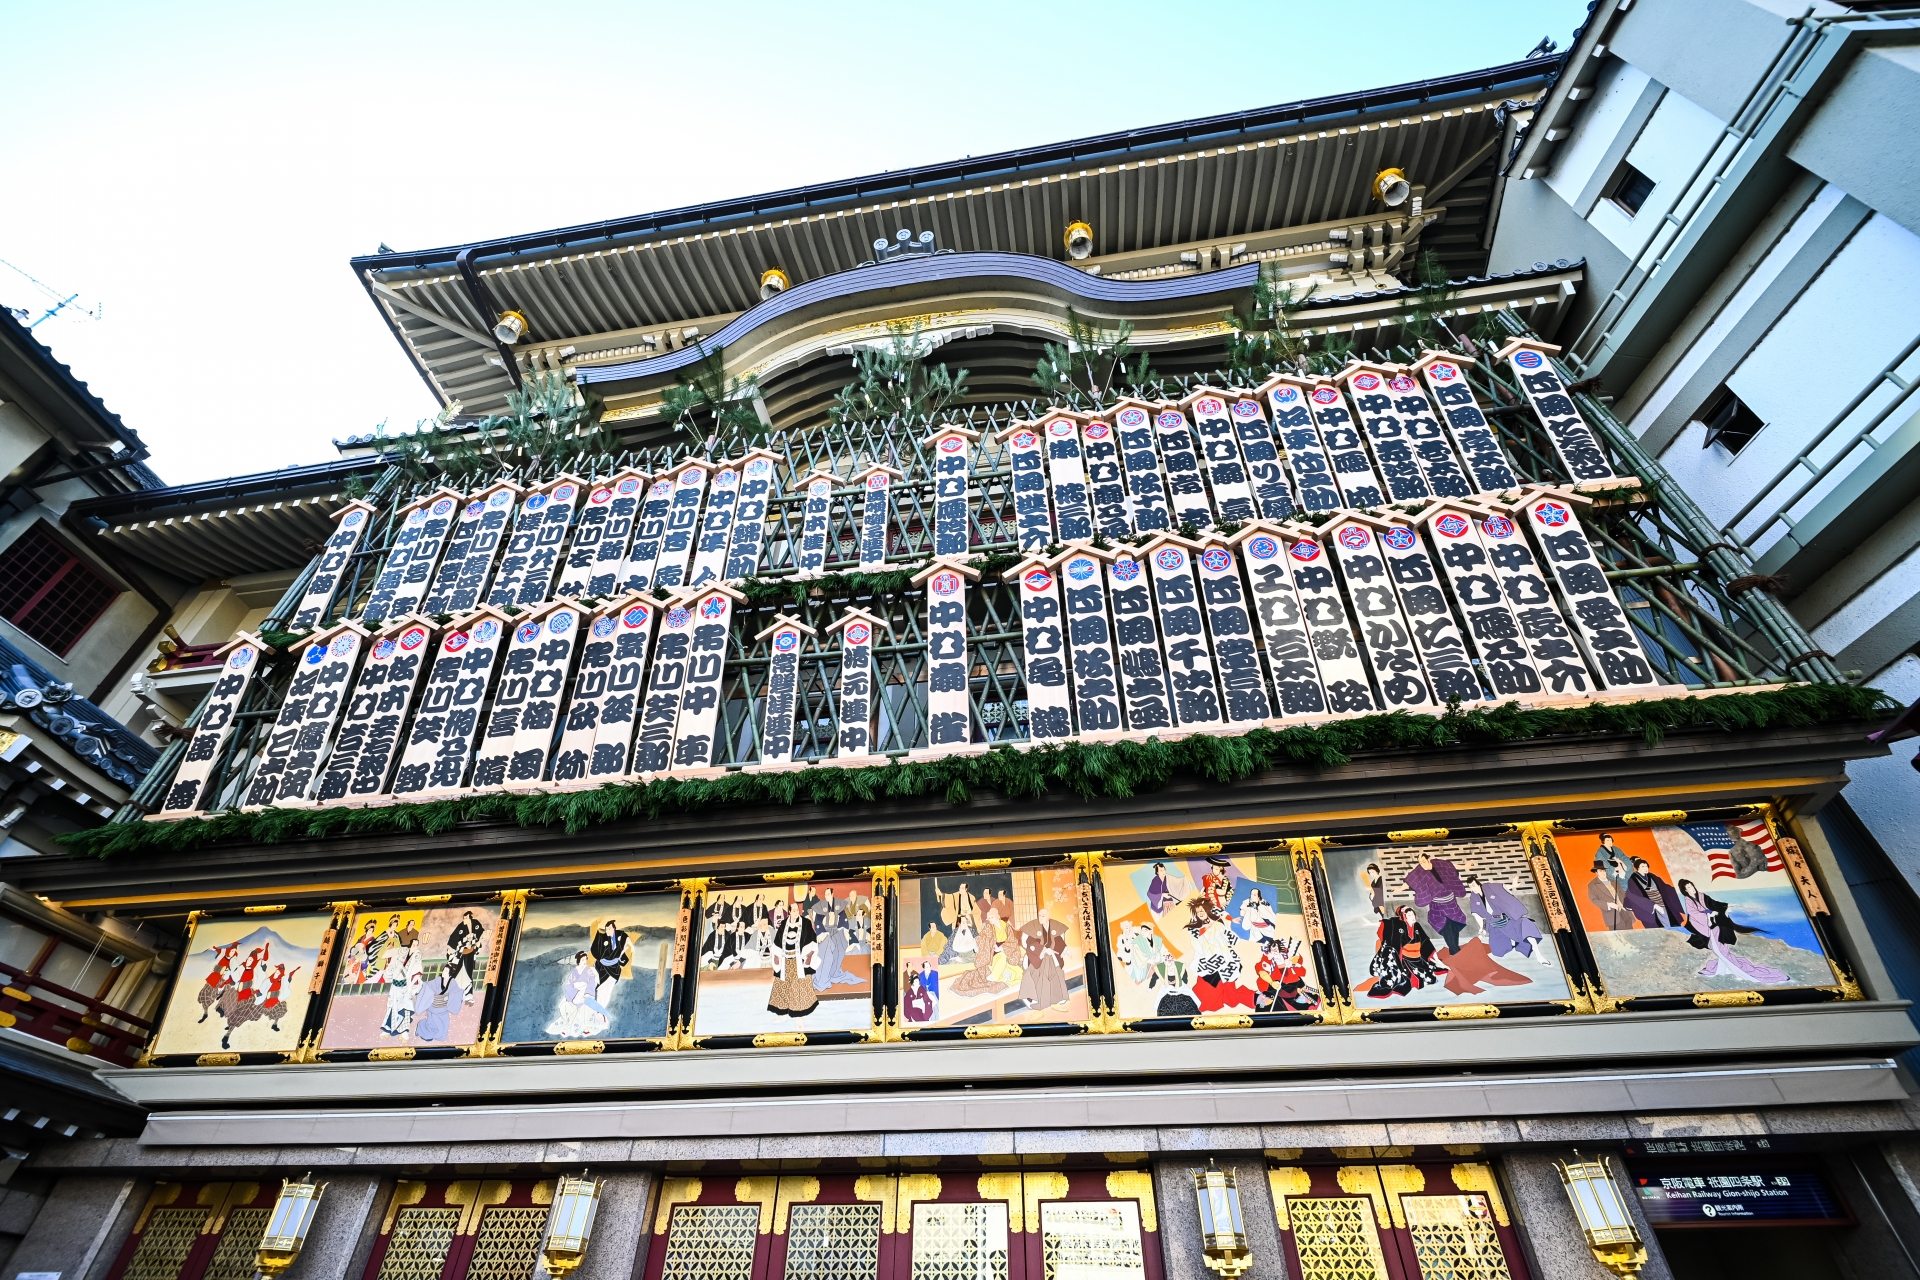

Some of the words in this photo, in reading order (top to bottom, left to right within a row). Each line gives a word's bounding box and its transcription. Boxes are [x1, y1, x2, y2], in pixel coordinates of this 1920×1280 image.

[1434, 383, 1516, 491] 片岡孝太郎
[1521, 371, 1613, 480] 片岡仁左衛門
[726, 480, 767, 579] 中村錦之助
[801, 498, 828, 570] 竹本連中
[1343, 555, 1426, 704] 中村かなめ
[1543, 530, 1653, 685] 片岡愛之助
[634, 633, 690, 774] 市川笑三郎
[674, 624, 726, 766] 市川中車
[840, 645, 870, 752] 清元連中
[1660, 1177, 1706, 1190] 京阪電車
[1707, 1175, 1765, 1189] 祇園四条駅
[1665, 1191, 1691, 1199] Keihan
[1692, 1190, 1721, 1199] Railway
[1722, 1189, 1760, 1199] Gion-shijo
[1760, 1189, 1788, 1197] Station
